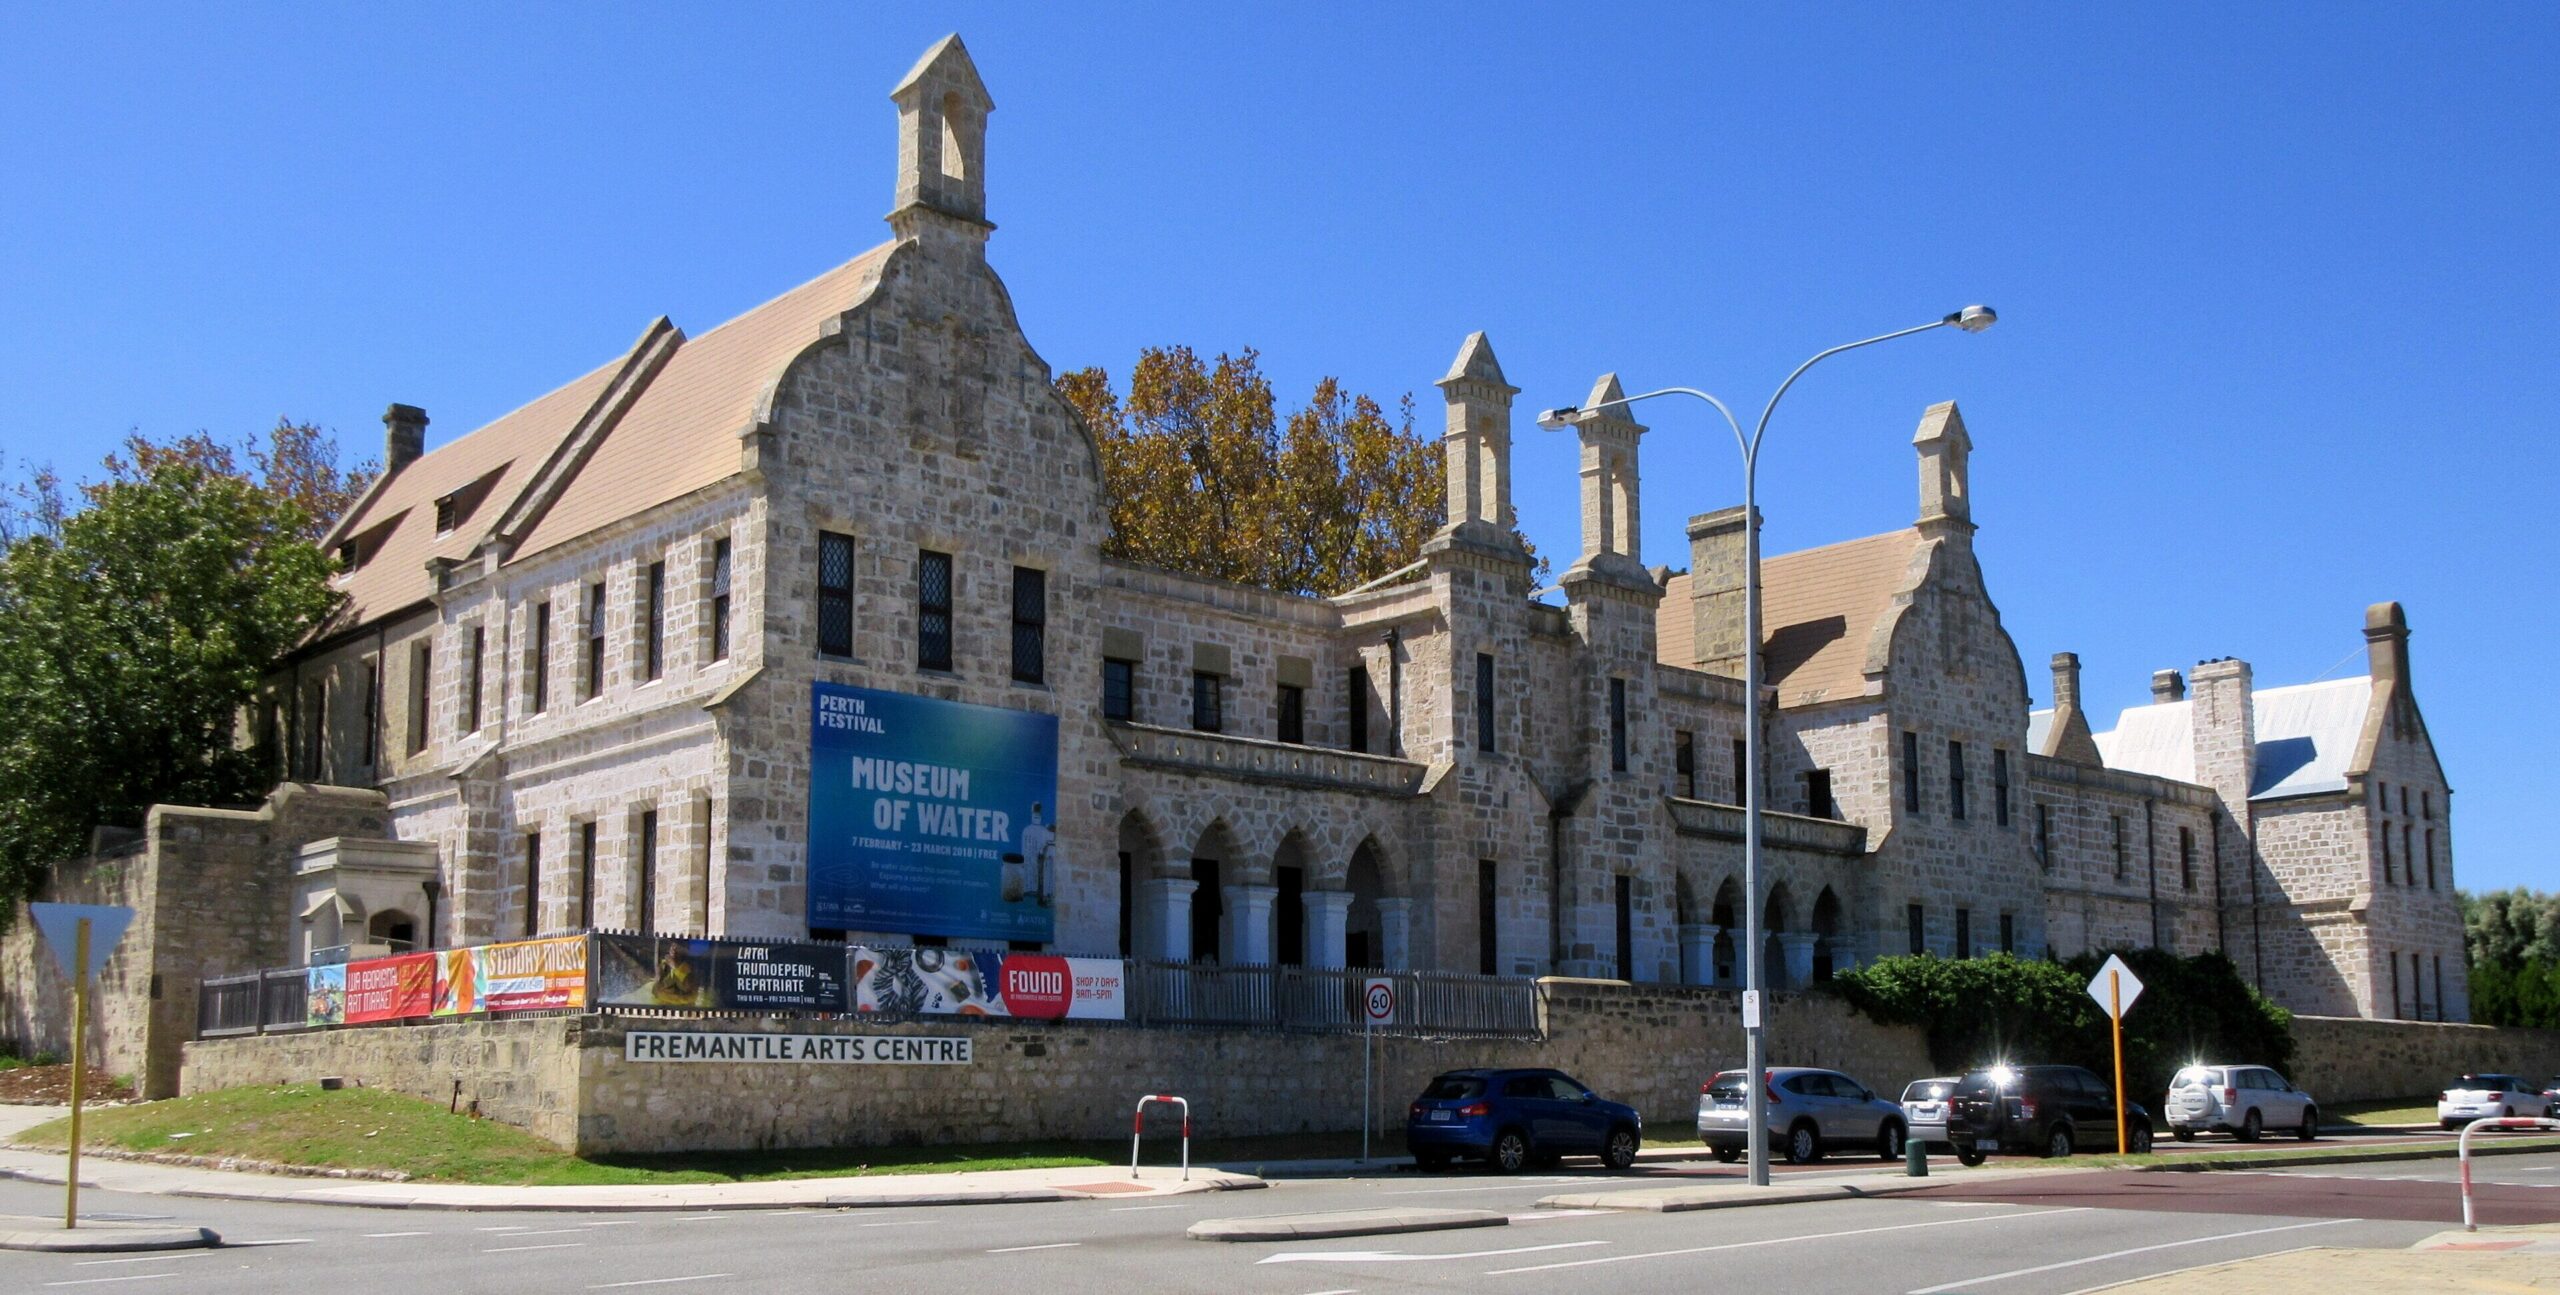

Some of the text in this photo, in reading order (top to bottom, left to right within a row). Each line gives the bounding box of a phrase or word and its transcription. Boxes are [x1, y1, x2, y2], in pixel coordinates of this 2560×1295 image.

[820, 695, 865, 715] PERTH
[820, 711, 885, 734] FESTIVAL
[852, 756, 970, 800] MUSEUM
[873, 798, 1010, 842] OF WATER
[852, 836, 857, 847] 7
[859, 838, 902, 851] FEBRUARY
[911, 842, 921, 852] 23
[923, 844, 950, 856] MARCH
[978, 849, 998, 860] FREE
[489, 940, 586, 977] SUNDAY MUSIC
[738, 947, 769, 960] LATAI
[348, 971, 361, 992] WA
[362, 966, 399, 991] ABORIGINAL
[737, 962, 815, 978] TAUMOEPEAU:
[1009, 970, 1062, 994] FOUND
[1076, 976, 1119, 988] SHOP 7 DAYS
[737, 978, 804, 992] REPATRIATE
[348, 993, 362, 1014] ART
[363, 989, 392, 1012] MARKET
[1371, 994, 1388, 1009] 60
[634, 1035, 969, 1061] FREMANTLE ARTS CENTRE
